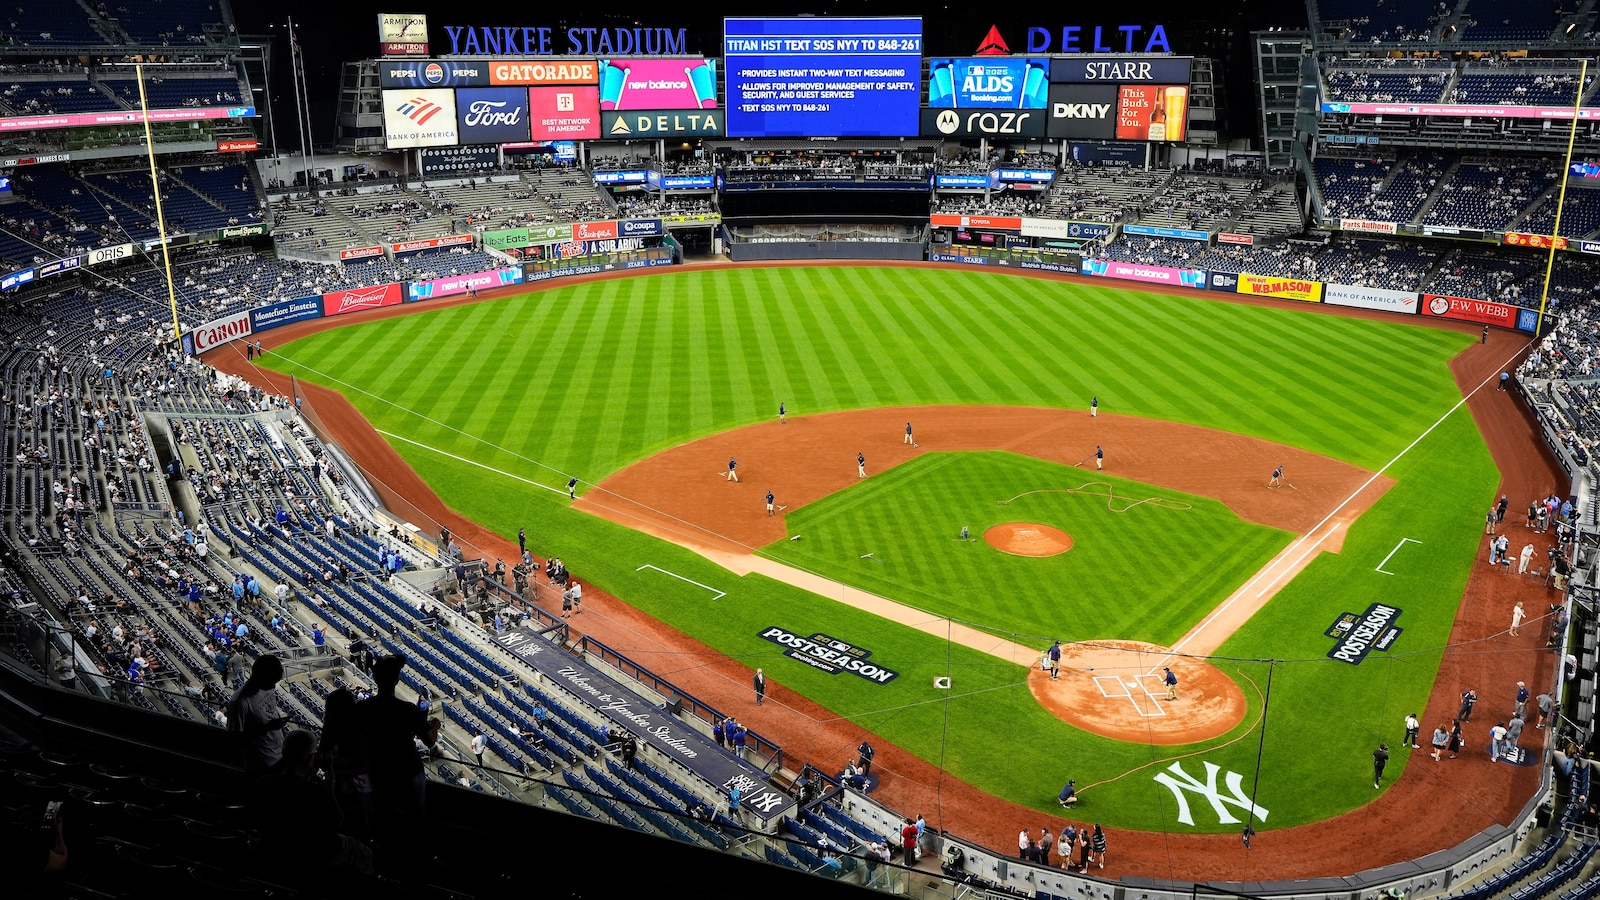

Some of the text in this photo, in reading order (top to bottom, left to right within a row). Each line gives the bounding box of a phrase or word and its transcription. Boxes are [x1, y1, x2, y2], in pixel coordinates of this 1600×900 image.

[443, 26, 687, 55] YANKEE STADIUM
[727, 39, 920, 51] TITAN HST TEXT SOS NYY TO 848-261
[1027, 25, 1171, 53] DELTA
[390, 70, 417, 78] PEPSI
[452, 69, 478, 77] PEPSI
[495, 64, 593, 81] GATORADE
[741, 69, 905, 78] PROVIDES INSTANT TWO-WAY TEXT MESSAGING
[1085, 62, 1153, 80] STARR
[649, 79, 688, 89] balance
[788, 82, 824, 90] IMPROVED
[826, 82, 874, 90] MANAGEMENT
[876, 82, 885, 90] OF
[887, 82, 915, 91] SAFETY,
[961, 76, 1014, 92] ALDS
[742, 91, 778, 99] SECURITY,
[970, 94, 1013, 103] Booking.com
[1122, 88, 1145, 98] This
[743, 104, 830, 112] TEXT SOS NYY TO 848-261
[1122, 98, 1149, 108] Bud's
[465, 100, 521, 126] Ford
[1053, 103, 1111, 119] DKNY
[1121, 108, 1138, 117] For
[637, 115, 718, 132] DELTA
[967, 112, 1031, 133] razr
[1121, 117, 1142, 127] You.
[36, 155, 57, 163] YANKEES
[223, 226, 263, 238] Poland Spring
[578, 227, 612, 239] Chick-fil-A
[633, 222, 655, 230] coupa
[1083, 227, 1109, 236] CLEAR
[1361, 222, 1394, 231] Authority
[506, 235, 527, 244] Eats
[591, 238, 644, 253] A SUB ABOVE
[96, 247, 124, 262] ORIS
[528, 265, 600, 281] StubHub StubHub StubHub
[1021, 261, 1078, 273] StubHub StubHub StubHub
[1116, 267, 1170, 280] new balance
[442, 275, 492, 291] new balance
[342, 293, 383, 307] Budweiser
[1361, 295, 1397, 304] AMERICA
[254, 308, 289, 321] Montefiore
[289, 301, 317, 312] Einstein
[1450, 299, 1509, 318] F.W. WEBB
[195, 317, 249, 349] Canon
[1333, 605, 1396, 662] POSTSEASON
[762, 628, 893, 683] POSTSEASON
[791, 652, 834, 672] Booking.com
[557, 665, 698, 759] Welcome to Yankee Stadium
[1153, 760, 1269, 826] NY
[750, 792, 782, 813] NY
